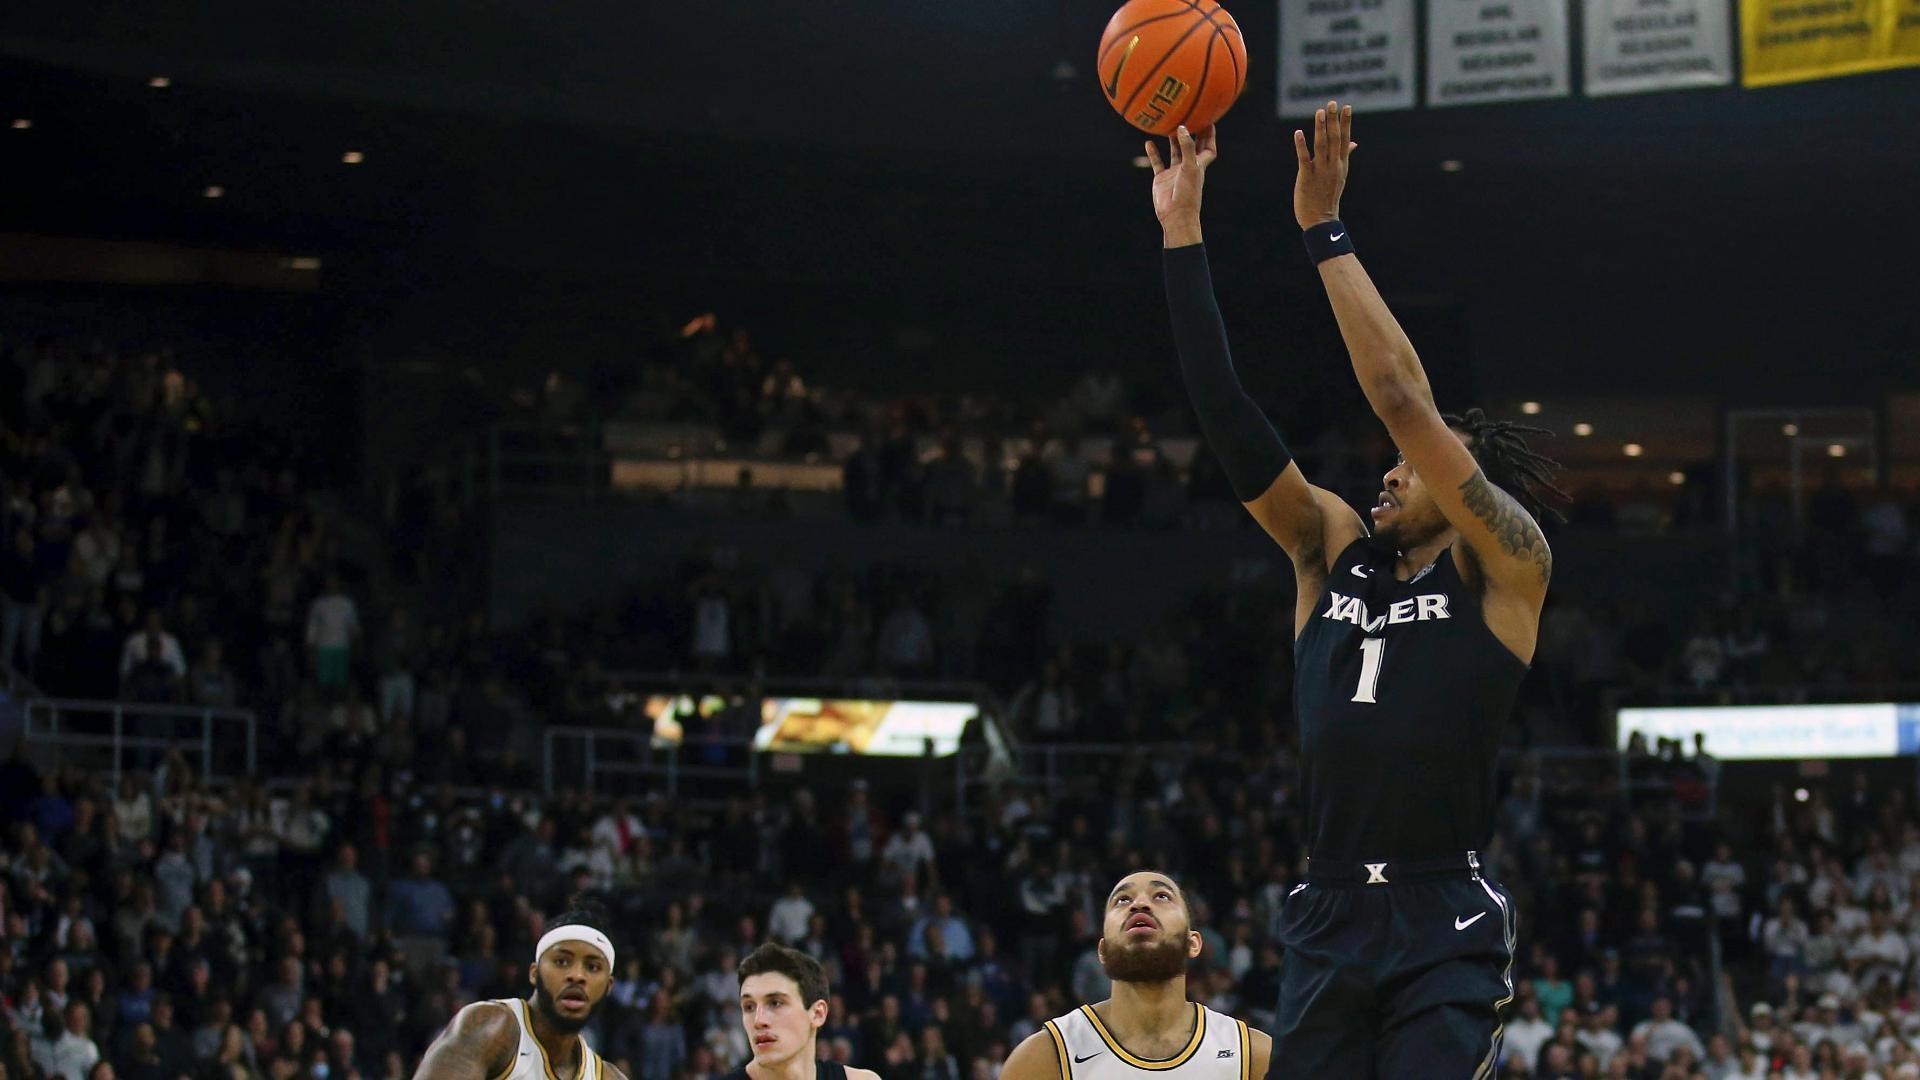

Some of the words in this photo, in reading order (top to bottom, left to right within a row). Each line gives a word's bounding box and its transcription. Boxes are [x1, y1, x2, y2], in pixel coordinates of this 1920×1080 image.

[1613, 9, 1697, 33] REGULAR
[1302, 35, 1388, 56] REGULAR
[1453, 25, 1540, 47] REGULAR
[1619, 35, 1693, 54] SEASON
[1305, 58, 1386, 77] SEASON
[1460, 52, 1535, 71] SEASON
[1598, 56, 1714, 80] CHAMPIONS
[1288, 77, 1401, 100] CHAMPIONS
[1441, 74, 1554, 97] CHAMPIONS
[1134, 74, 1184, 129] ELITE
[1322, 591, 1452, 633] XAVER
[1350, 637, 1386, 704] 1
[1364, 863, 1389, 884] X
